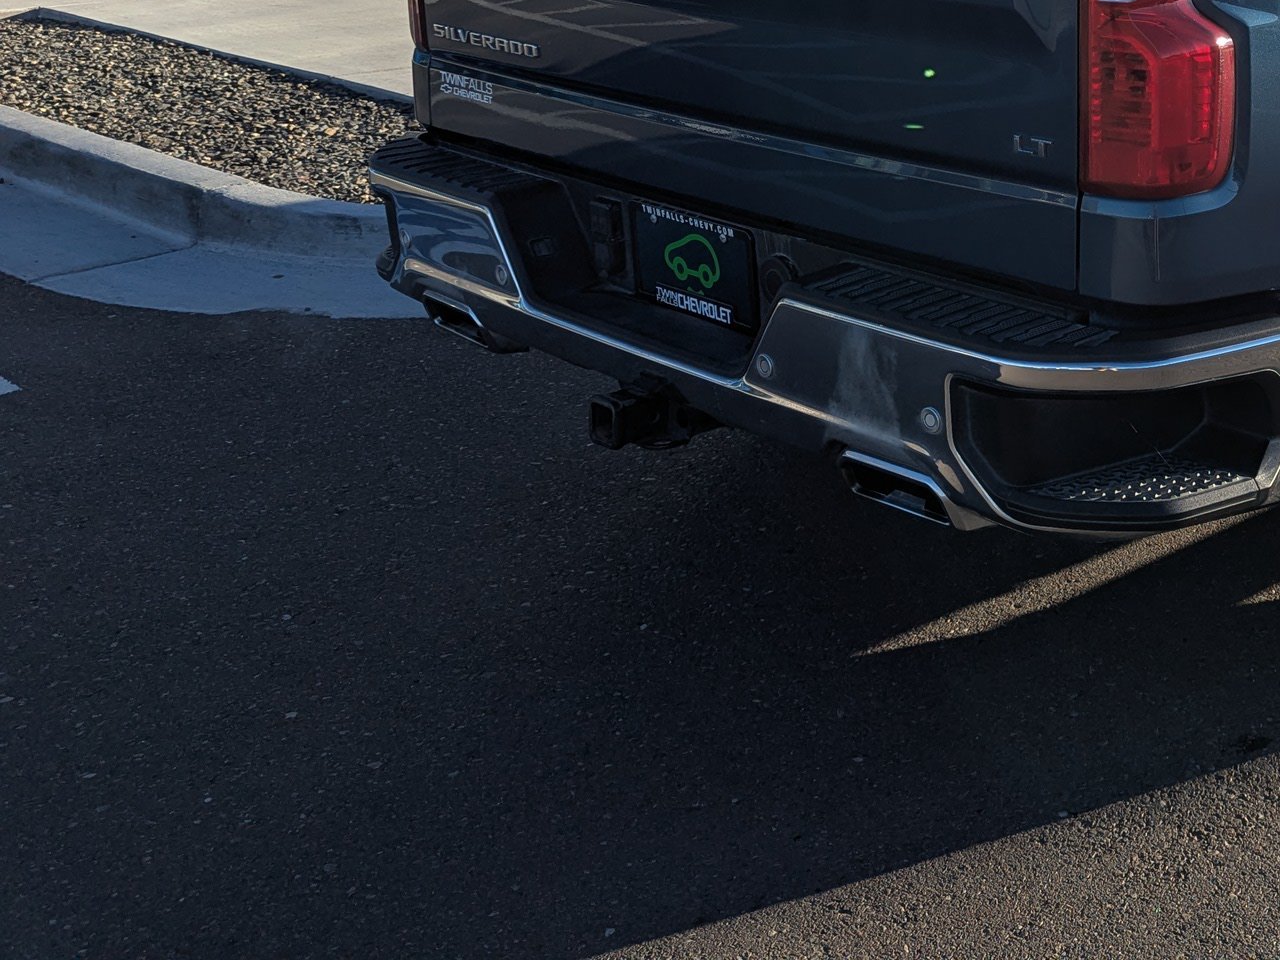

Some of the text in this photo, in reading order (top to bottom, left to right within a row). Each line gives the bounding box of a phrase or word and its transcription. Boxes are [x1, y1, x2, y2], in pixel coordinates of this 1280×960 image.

[433, 23, 539, 57] SILVERADO
[453, 86, 493, 104] CHEVROLET
[1013, 134, 1052, 158] LT
[655, 286, 731, 324] TWIN CHEVROLET
[656, 294, 679, 307] FALLS
